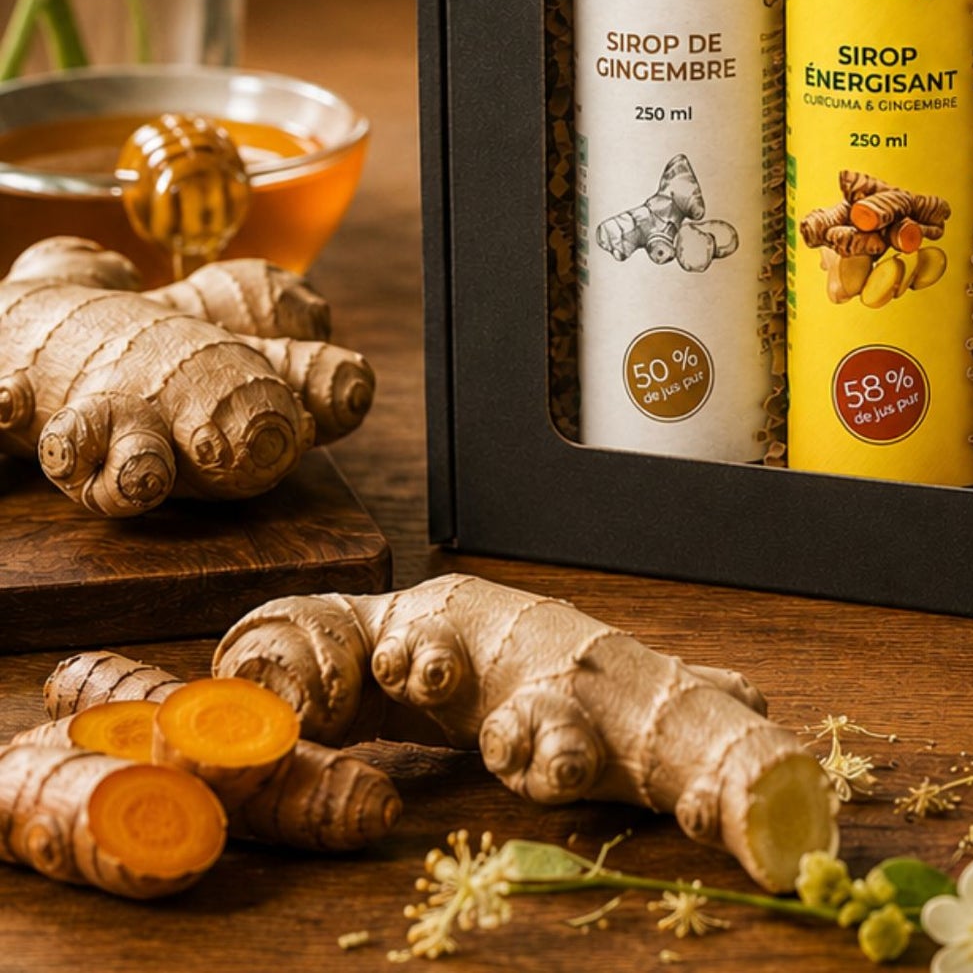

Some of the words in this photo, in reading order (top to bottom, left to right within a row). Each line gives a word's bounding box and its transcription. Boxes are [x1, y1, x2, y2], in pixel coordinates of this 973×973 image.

[606, 31, 679, 55] SIROP
[688, 33, 722, 54] DE
[838, 45, 918, 67] SIROP
[596, 57, 736, 82] GINGEMBRE
[804, 62, 958, 94] ÉNERGISANT
[803, 92, 862, 111] CURCUMA
[878, 96, 958, 112] GINGEMBRE
[635, 106, 665, 121] 250
[671, 107, 693, 121] ml
[849, 133, 881, 148] 250
[885, 133, 908, 148] ml
